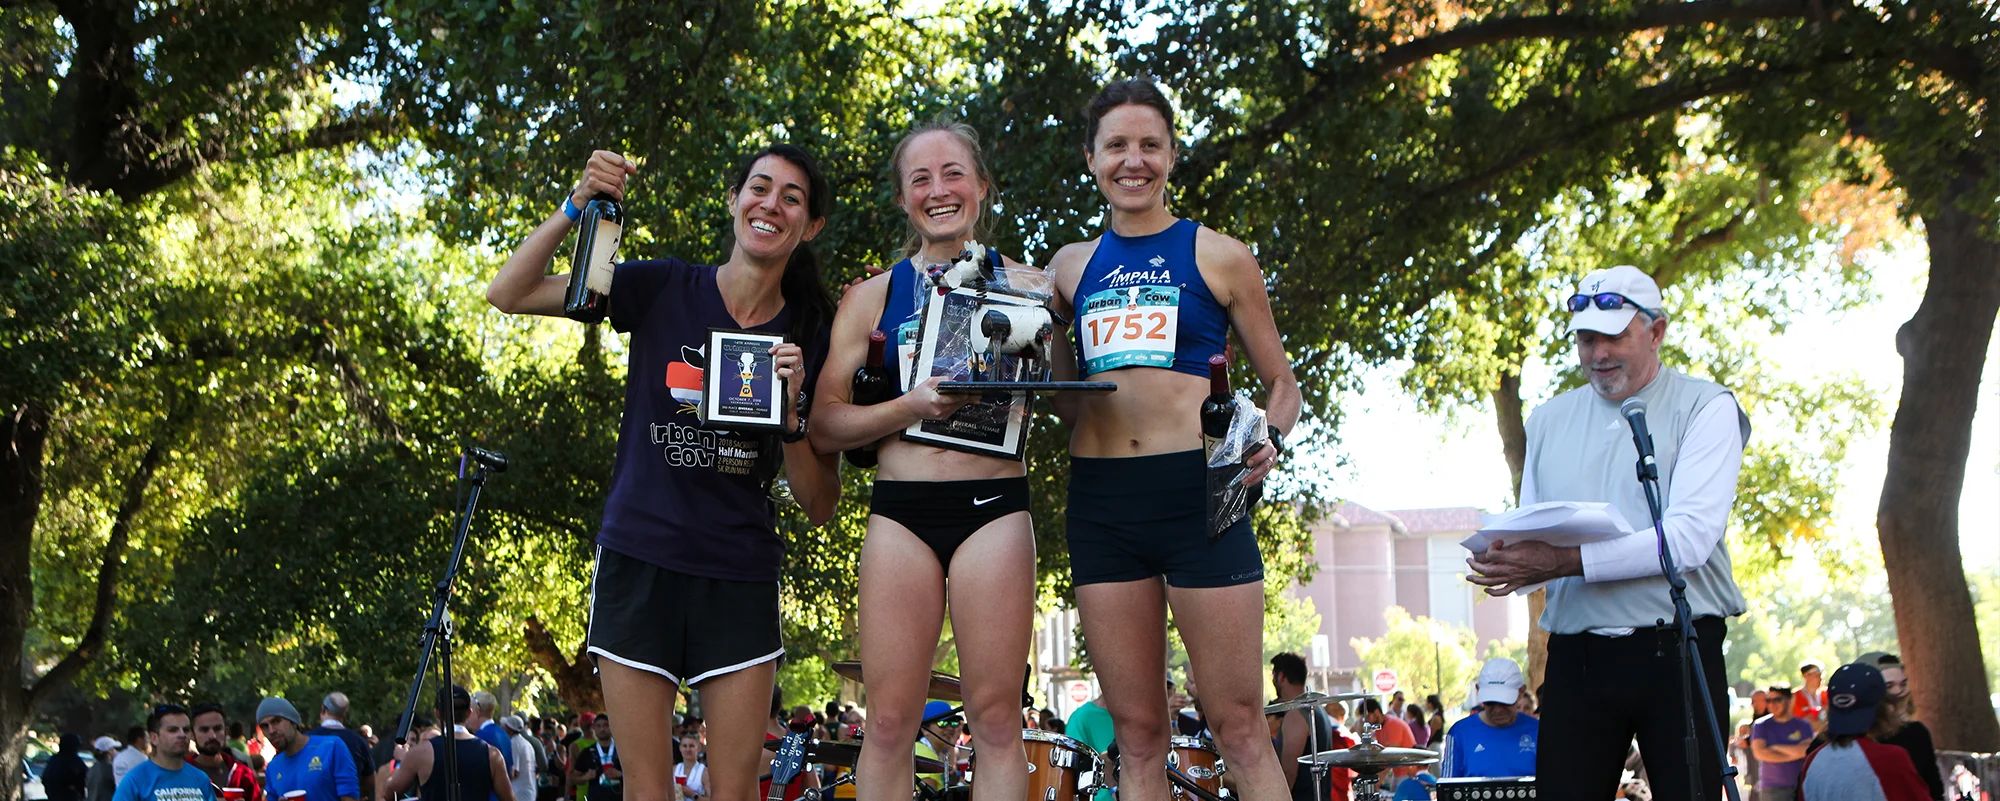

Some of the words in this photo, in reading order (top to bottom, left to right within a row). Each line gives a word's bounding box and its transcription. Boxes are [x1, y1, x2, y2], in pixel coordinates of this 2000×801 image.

[1111, 270, 1170, 282] IMPALA
[1088, 297, 1122, 309] Urban
[1088, 312, 1167, 347] 1752
[982, 425, 1000, 433] FEMALE
[650, 422, 716, 450] rban
[718, 438, 733, 447] 2018
[718, 446, 734, 457] Half
[154, 787, 203, 797] CALIFORNIA
